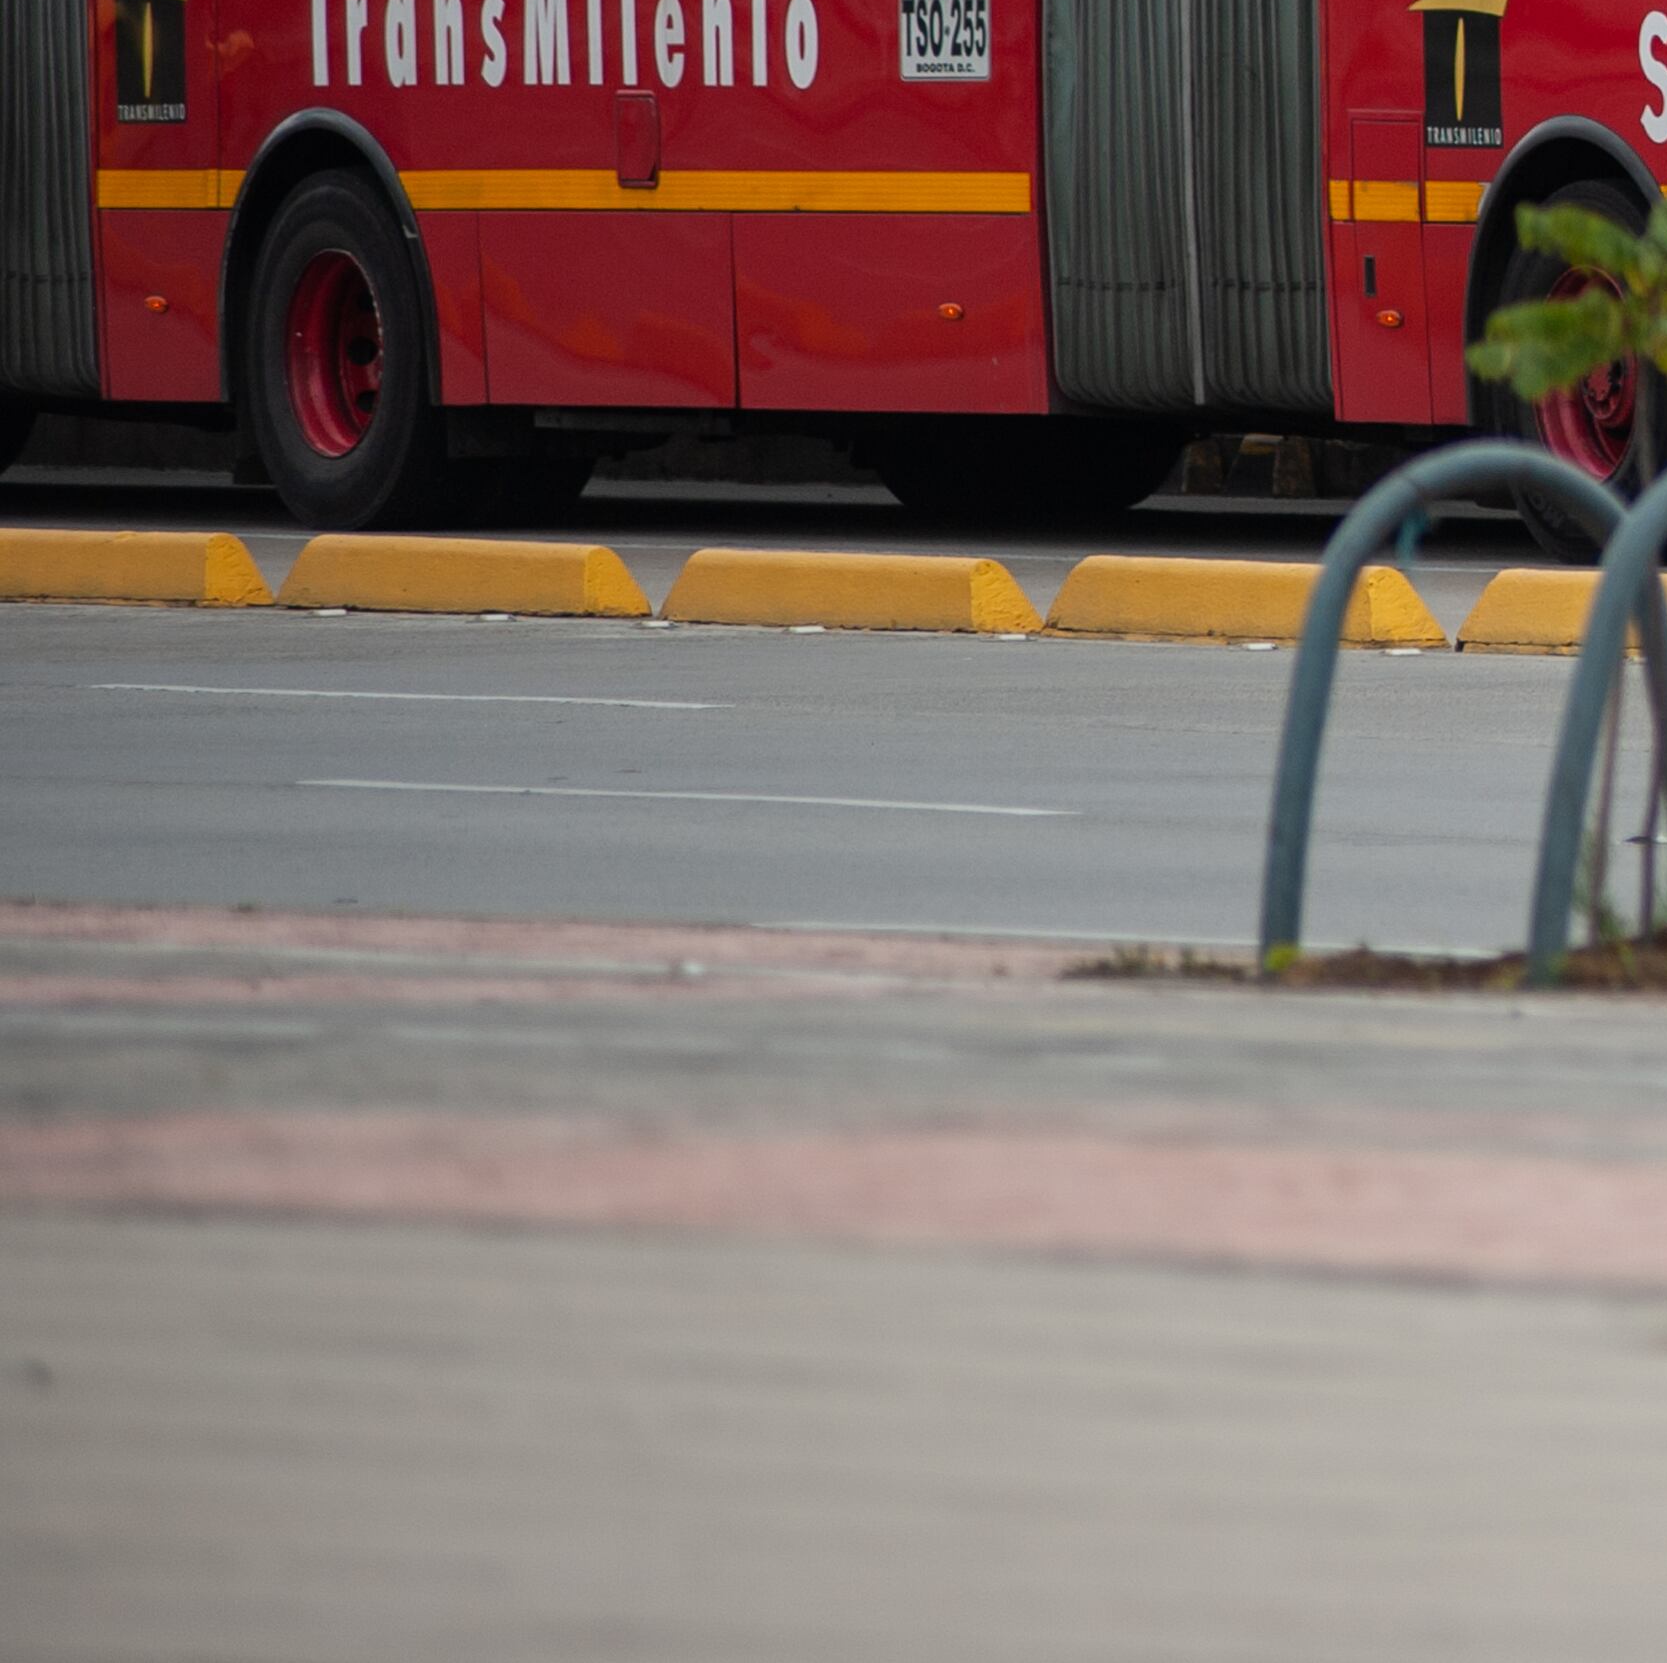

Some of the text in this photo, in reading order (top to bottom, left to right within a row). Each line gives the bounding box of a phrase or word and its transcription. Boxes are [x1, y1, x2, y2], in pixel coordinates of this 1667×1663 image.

[916, 63, 955, 73] BOGOTA
[117, 102, 186, 121] TRANSMILENIO
[1426, 126, 1502, 146] TRANSMILENIO
